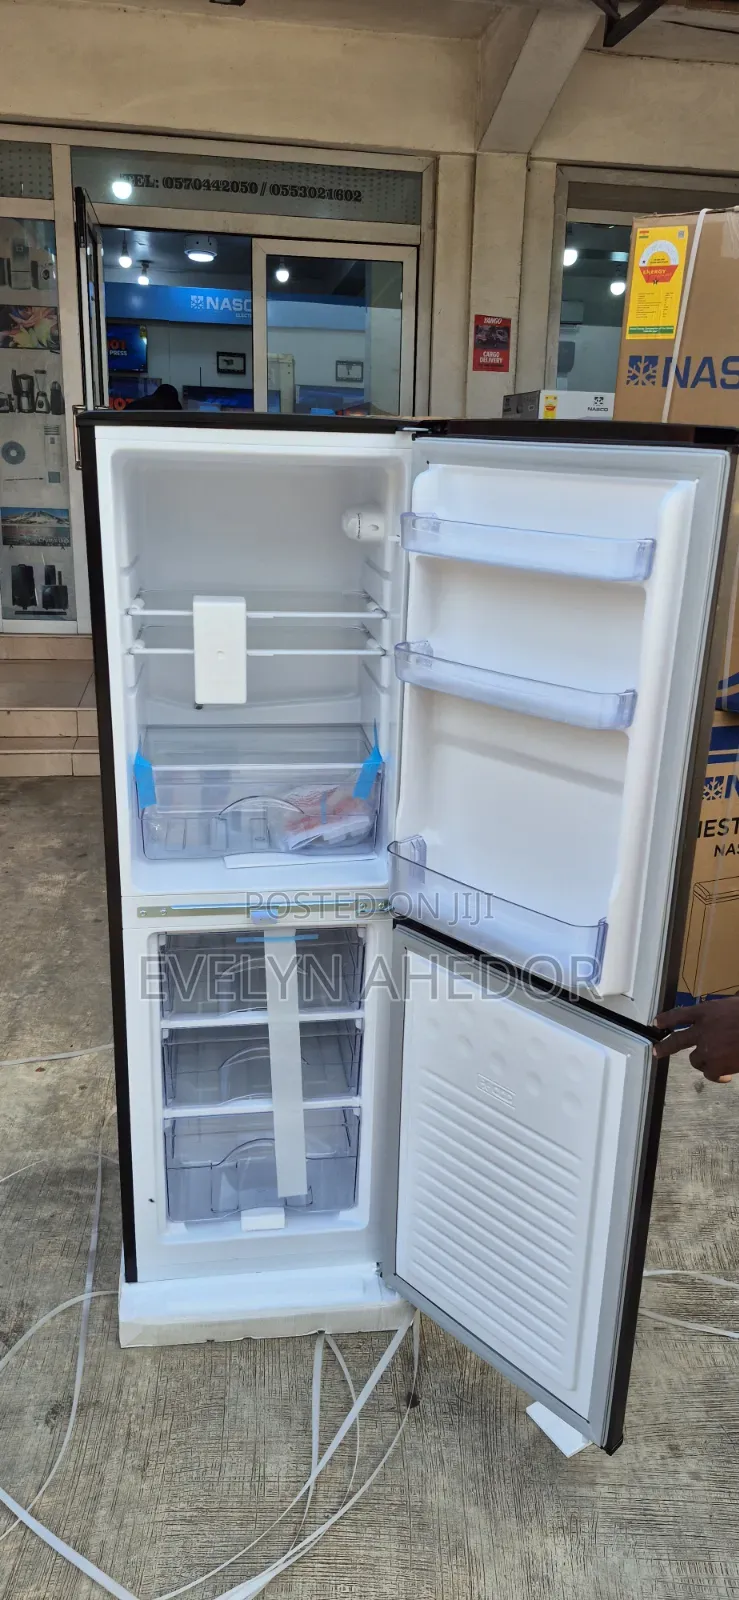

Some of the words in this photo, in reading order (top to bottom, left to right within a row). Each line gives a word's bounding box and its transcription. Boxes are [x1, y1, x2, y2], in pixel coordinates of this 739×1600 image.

[119, 173, 160, 189] TEL:
[162, 176, 258, 194] 0570442050
[269, 183, 363, 202] 0553021602
[483, 317, 503, 325] YANGO
